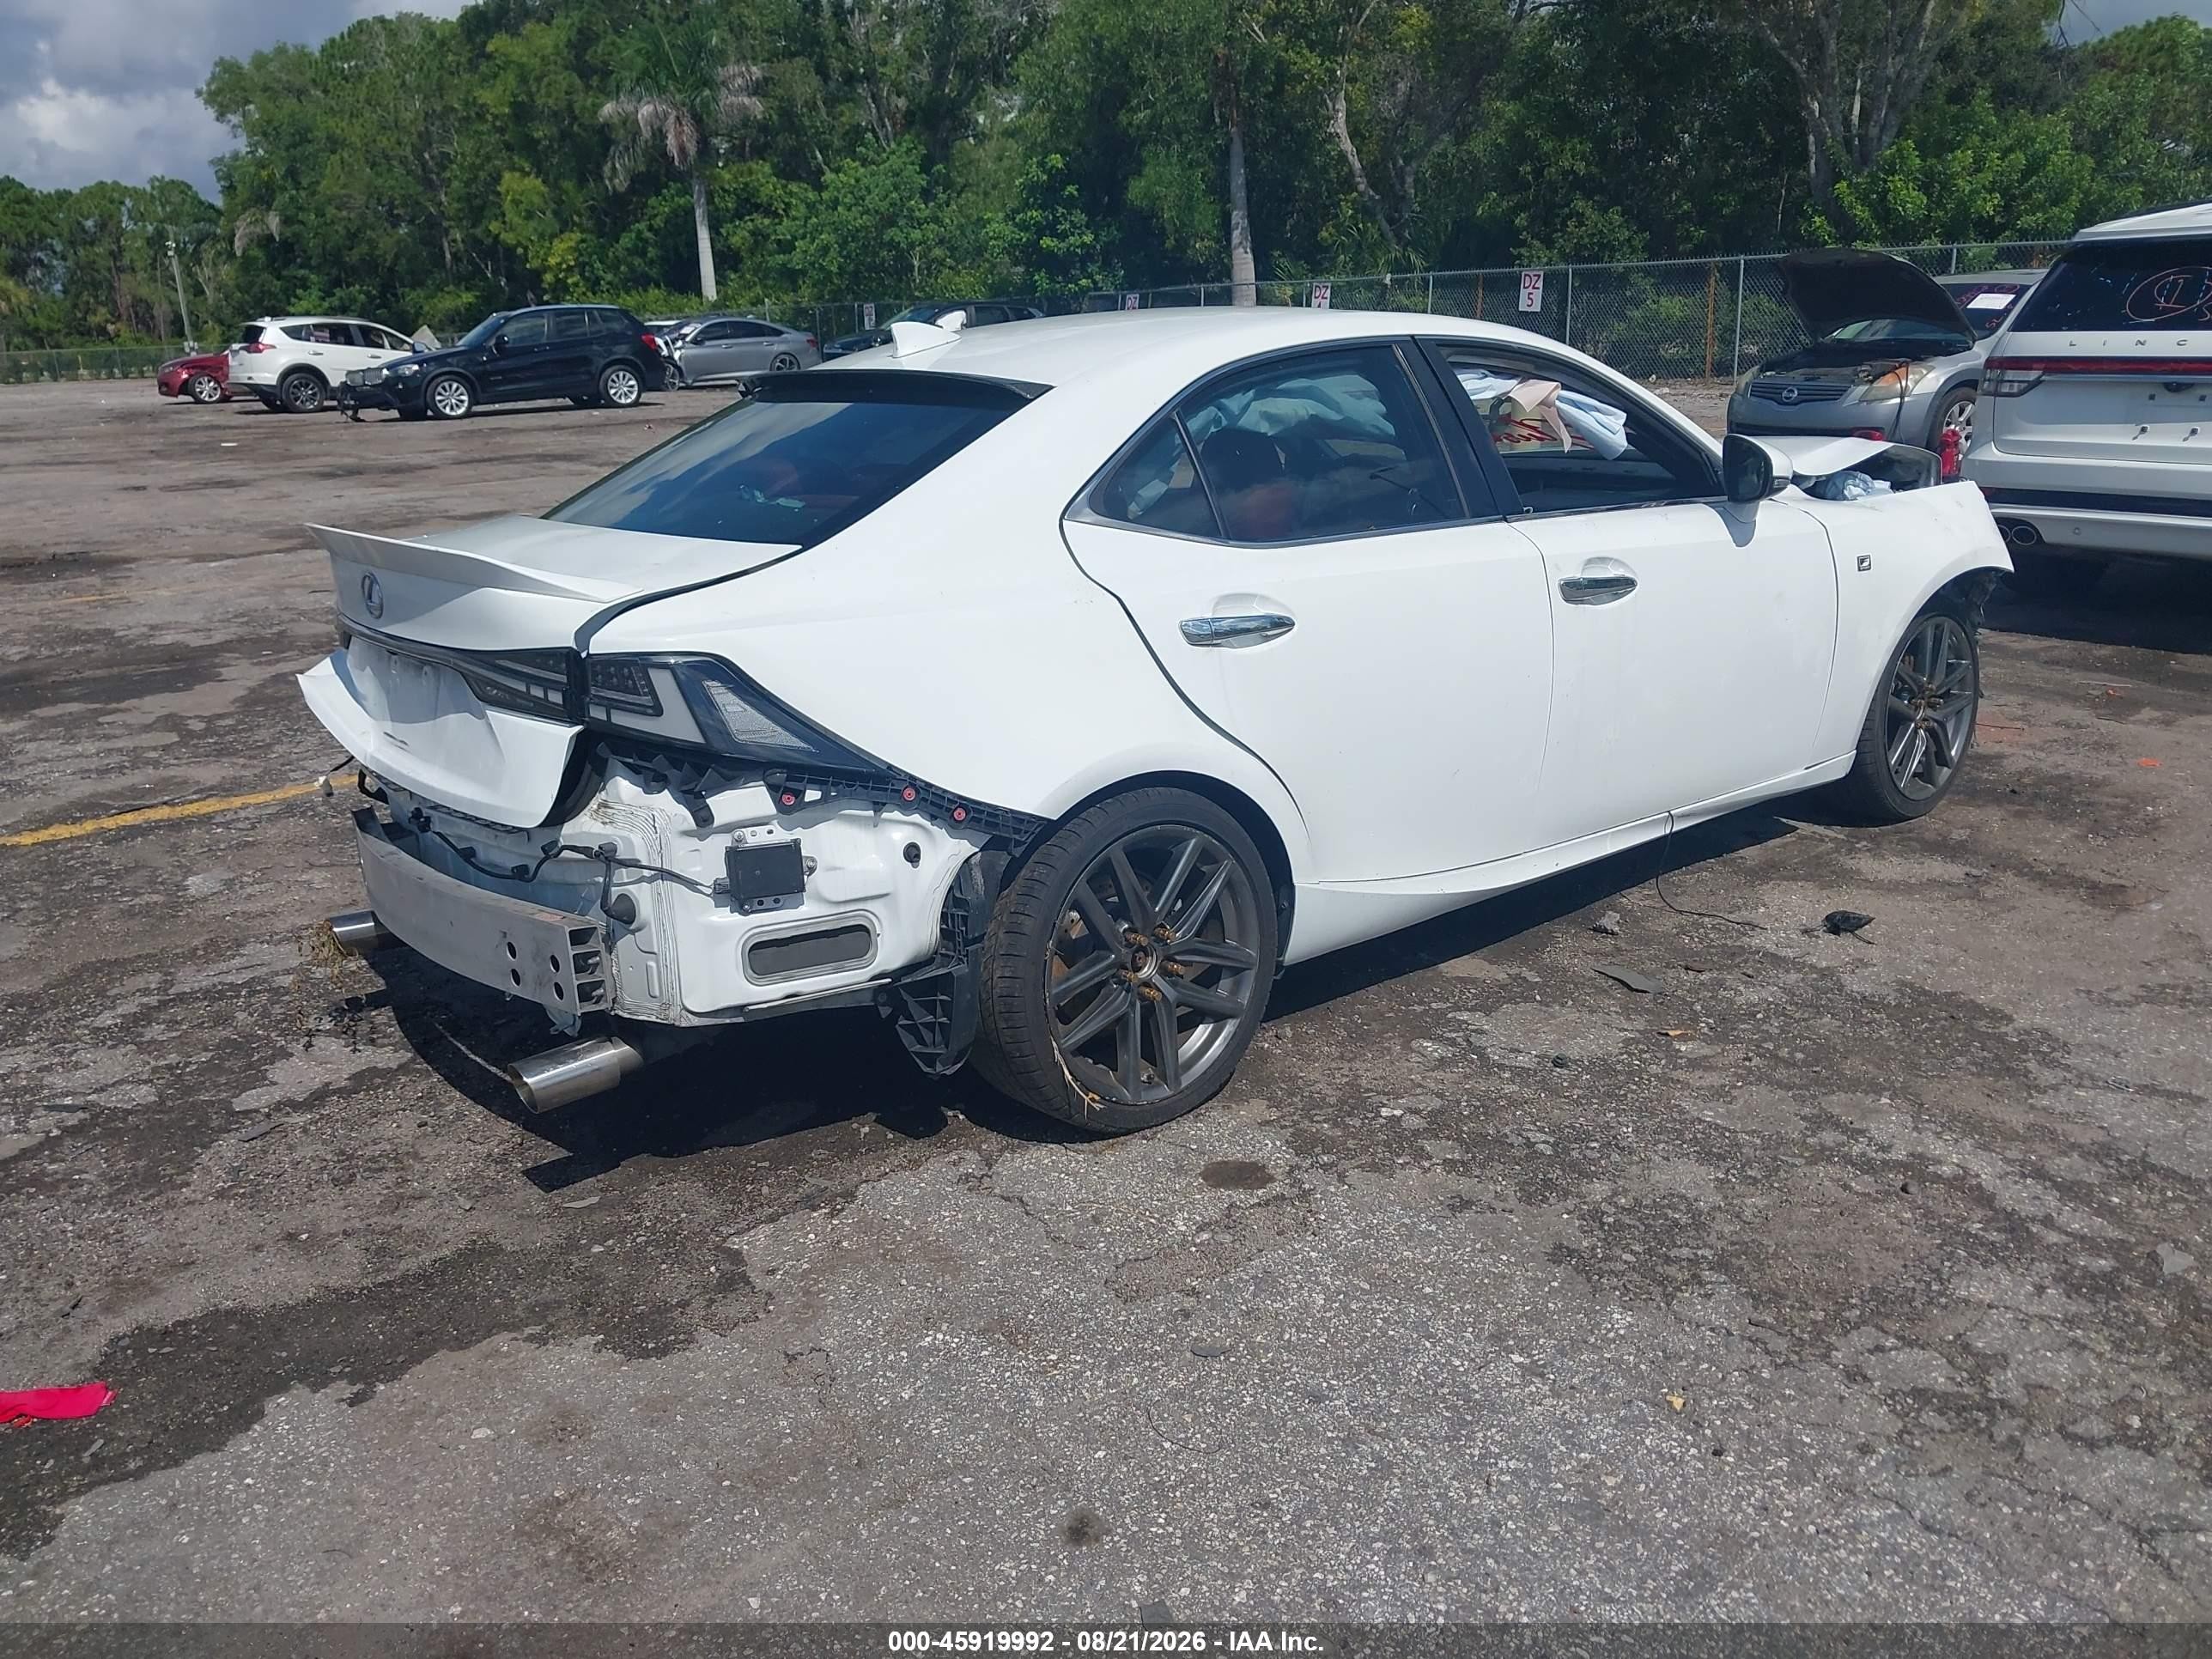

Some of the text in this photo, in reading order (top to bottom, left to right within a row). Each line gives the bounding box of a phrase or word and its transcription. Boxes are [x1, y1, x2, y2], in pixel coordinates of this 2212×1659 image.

[1522, 273, 1541, 290] DZ
[1314, 285, 1329, 300] DZ
[1526, 292, 1534, 307] 5
